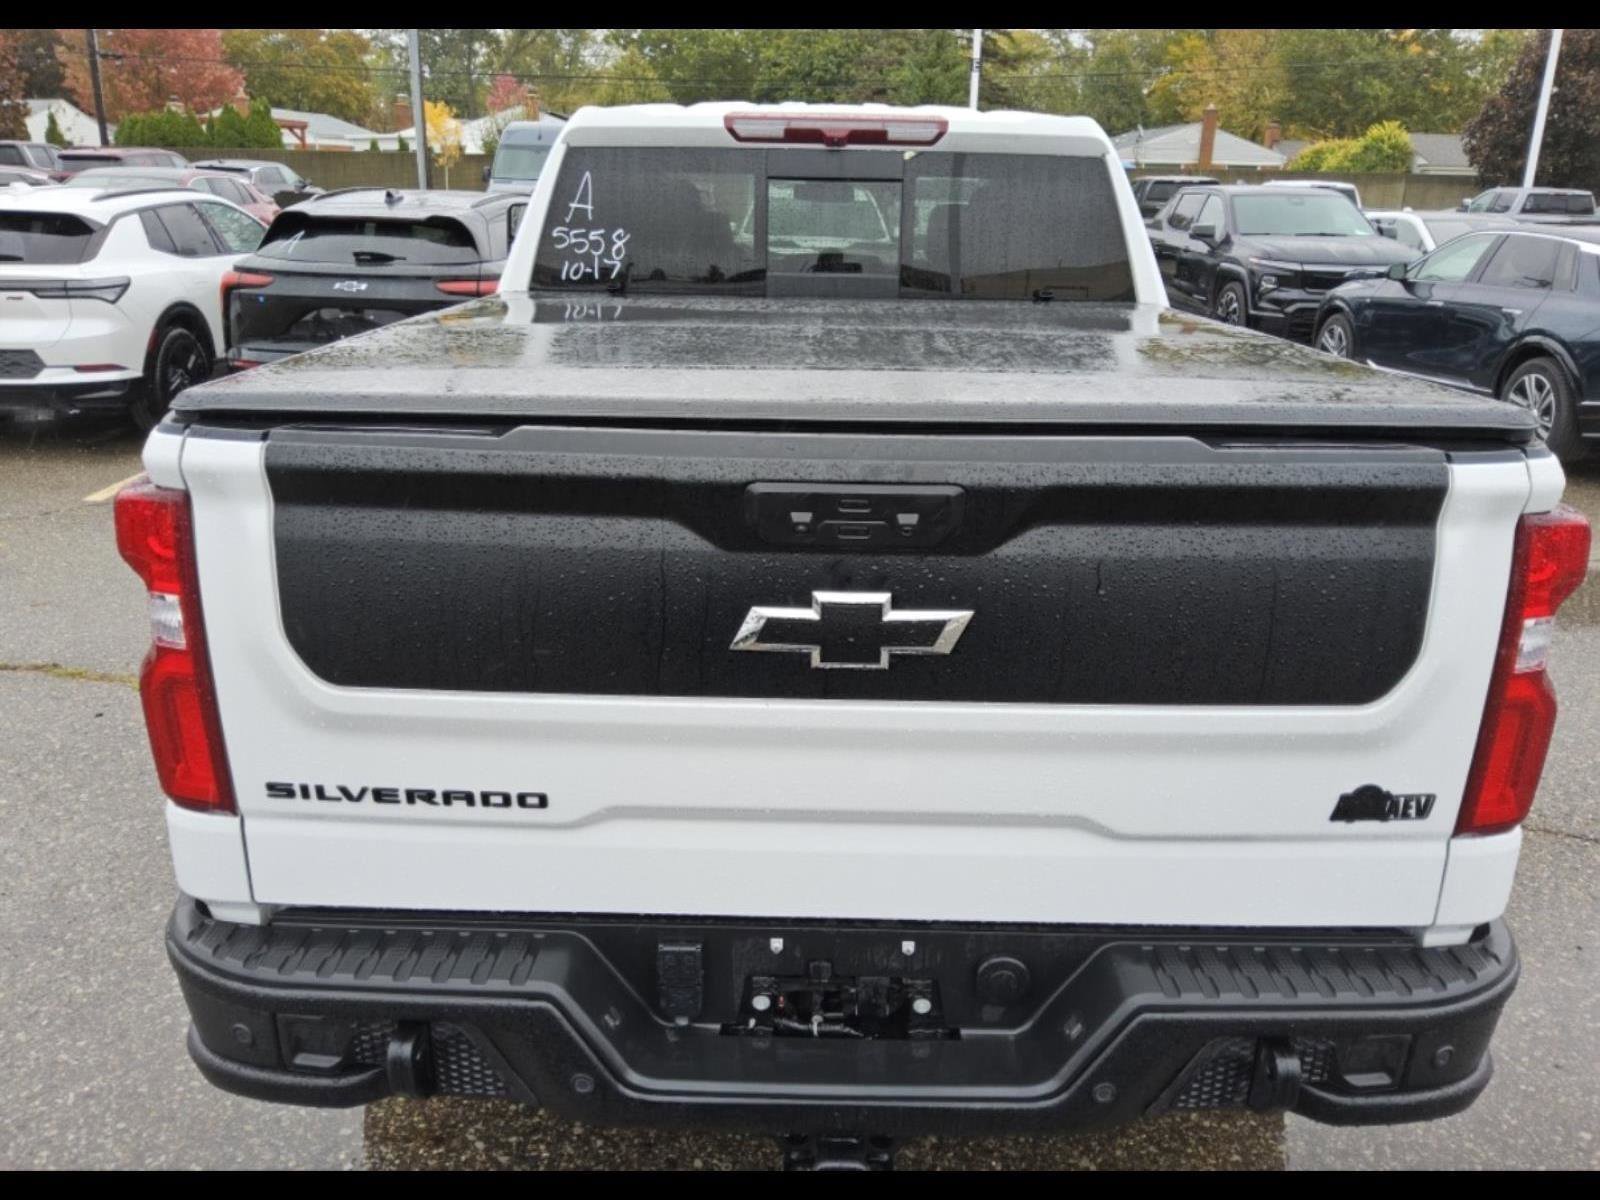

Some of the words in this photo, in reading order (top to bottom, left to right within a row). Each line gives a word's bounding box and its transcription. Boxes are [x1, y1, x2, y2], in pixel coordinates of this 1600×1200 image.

[565, 171, 594, 223] A
[551, 226, 631, 260] 5558
[561, 254, 621, 280] 10-17
[265, 782, 549, 809] SILVERADO
